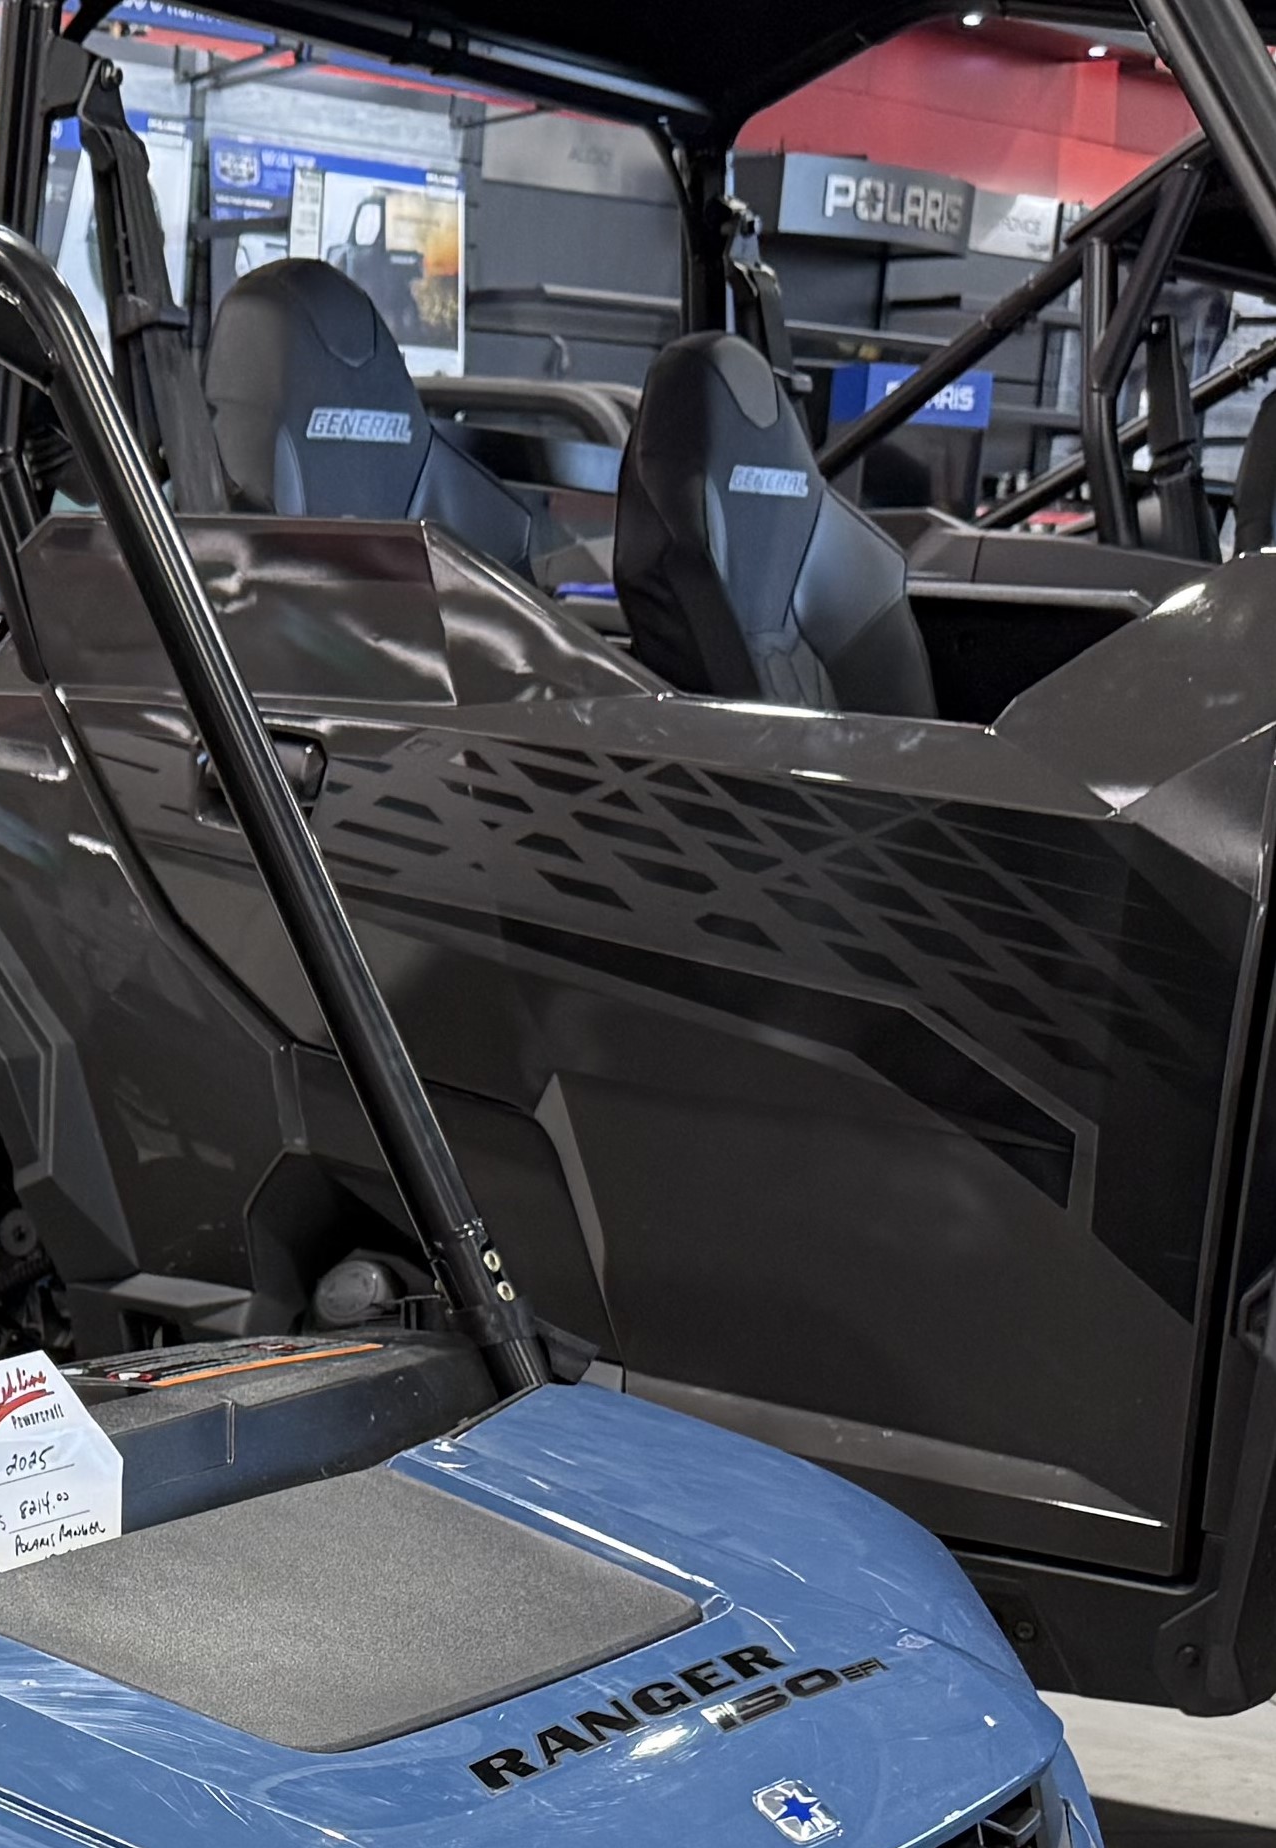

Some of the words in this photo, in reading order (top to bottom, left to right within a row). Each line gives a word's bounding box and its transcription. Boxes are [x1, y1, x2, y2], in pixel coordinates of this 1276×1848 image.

[824, 173, 964, 233] POLARIS
[309, 410, 410, 440] GENERAL
[11, 1403, 65, 1430] Powercraft
[5, 1445, 55, 1476] 2025
[467, 1644, 787, 1796] RANGER
[700, 1667, 843, 1733] 150
